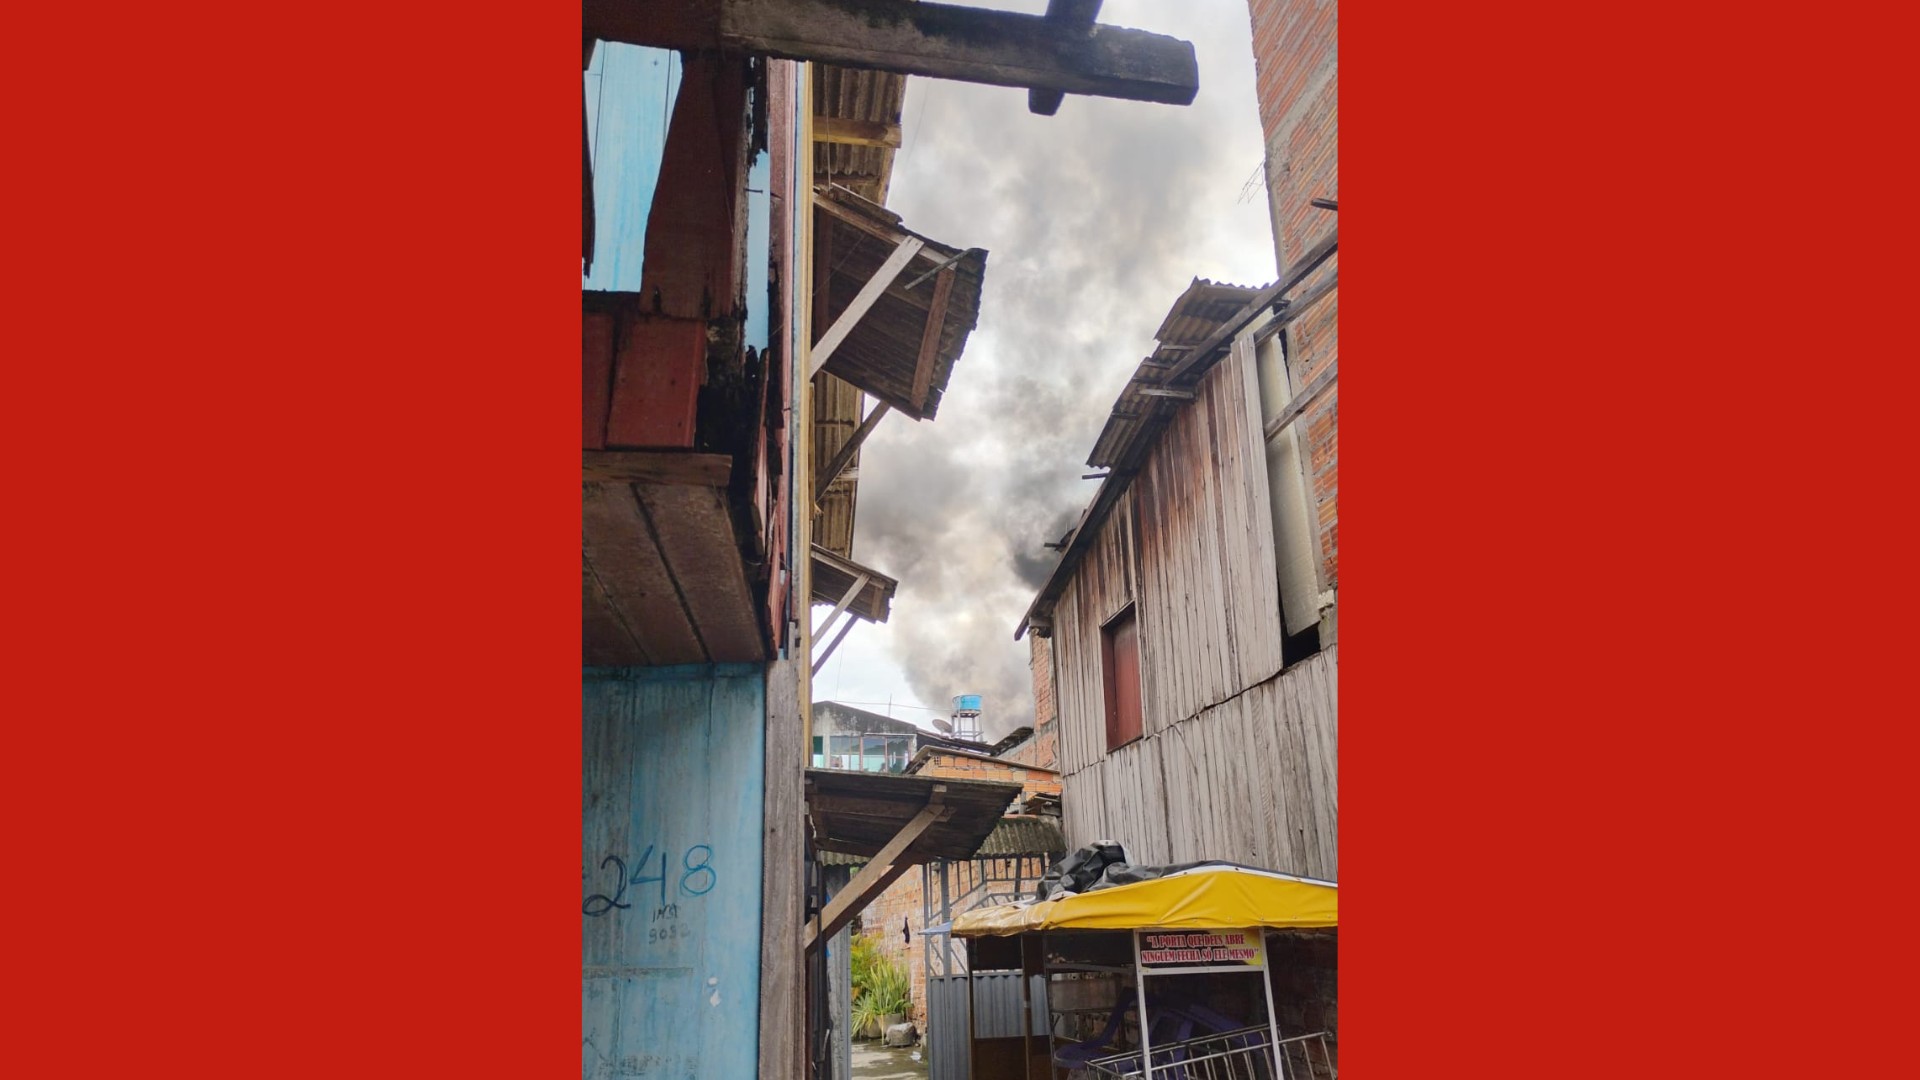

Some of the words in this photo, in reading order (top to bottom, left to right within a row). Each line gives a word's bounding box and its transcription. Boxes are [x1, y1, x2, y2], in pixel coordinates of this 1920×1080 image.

[582, 844, 717, 918] 248
[1160, 935, 1187, 948] PORTA
[1187, 934, 1203, 948] QUE
[1204, 934, 1224, 946] DEUS
[1225, 934, 1245, 945] ABRE
[1177, 949, 1201, 962] FECHA
[1213, 948, 1229, 961] ELE
